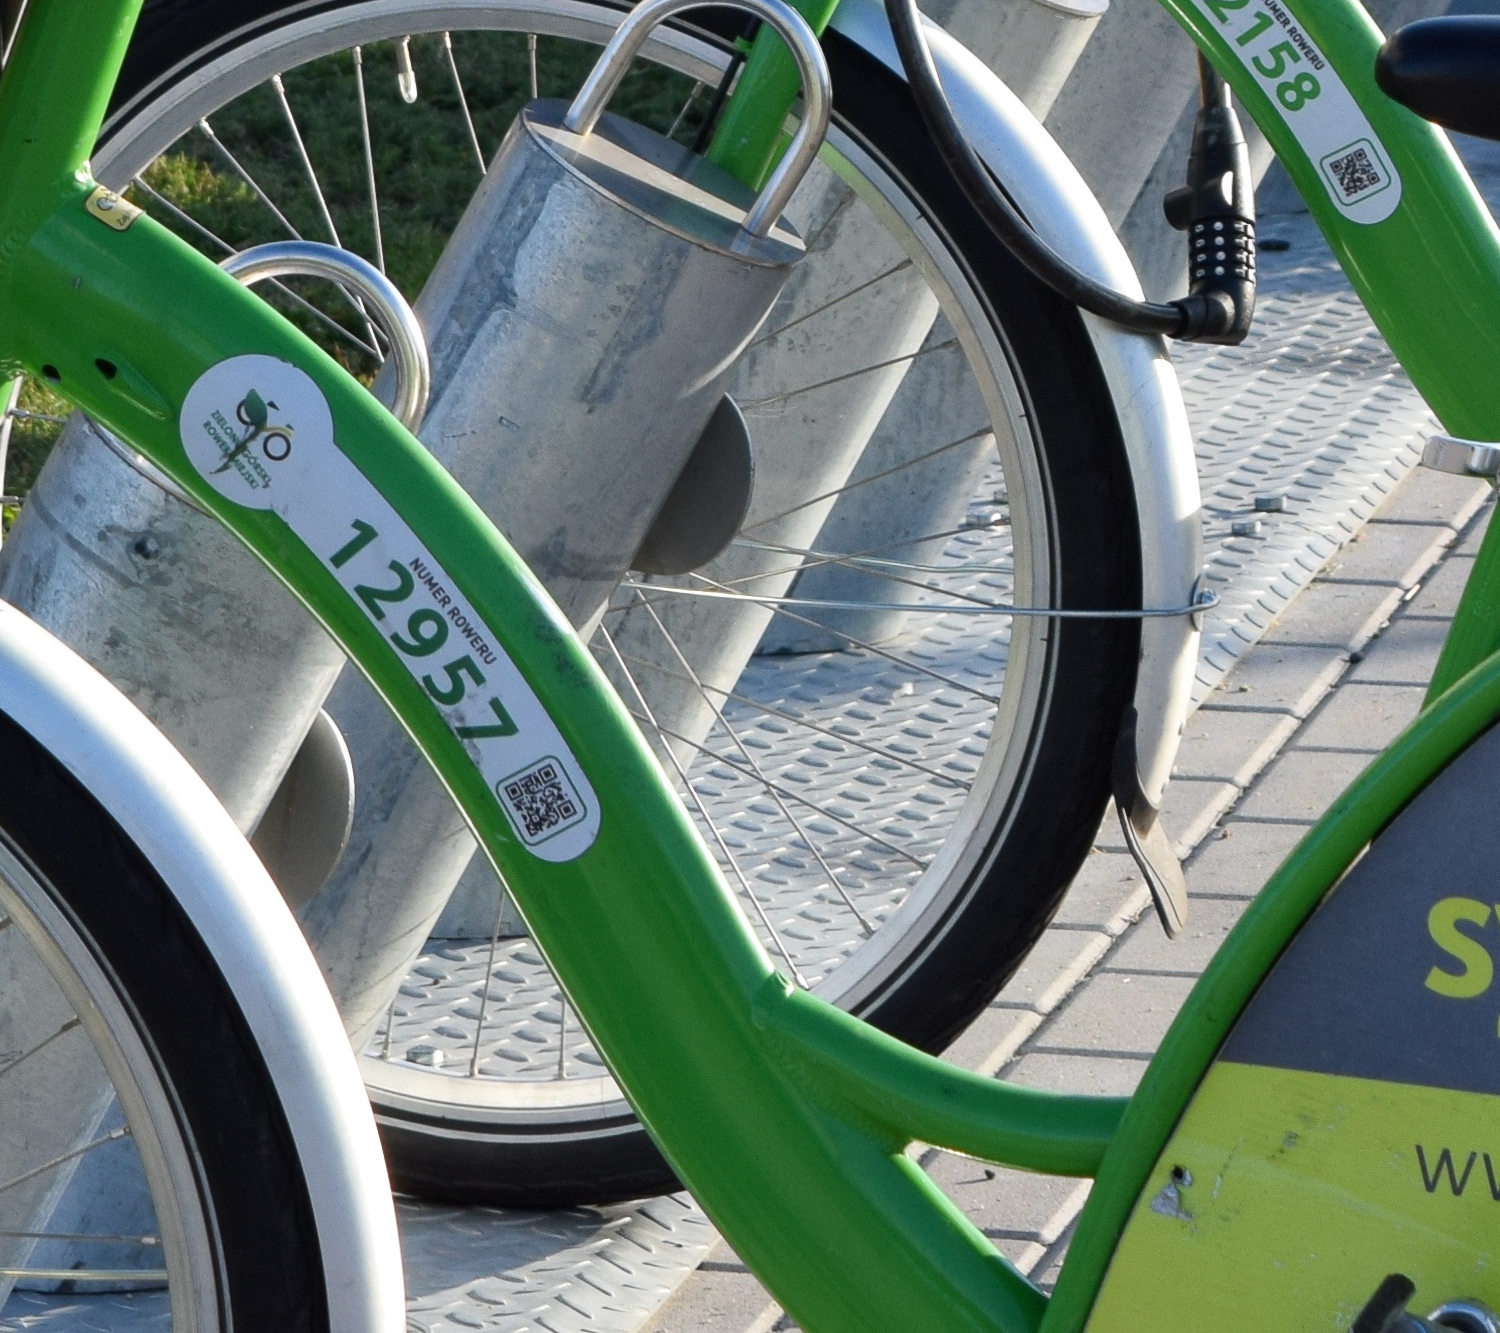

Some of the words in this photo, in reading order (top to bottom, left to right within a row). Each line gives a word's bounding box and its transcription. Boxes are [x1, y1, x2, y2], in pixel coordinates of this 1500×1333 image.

[1285, 25, 1326, 71] ROWERU
[202, 420, 231, 455] ROWER
[209, 409, 272, 486] ZIELONGÓRSKI
[327, 518, 521, 741] 12957
[408, 556, 453, 610] NUMER
[446, 604, 497, 666] ROWERU
